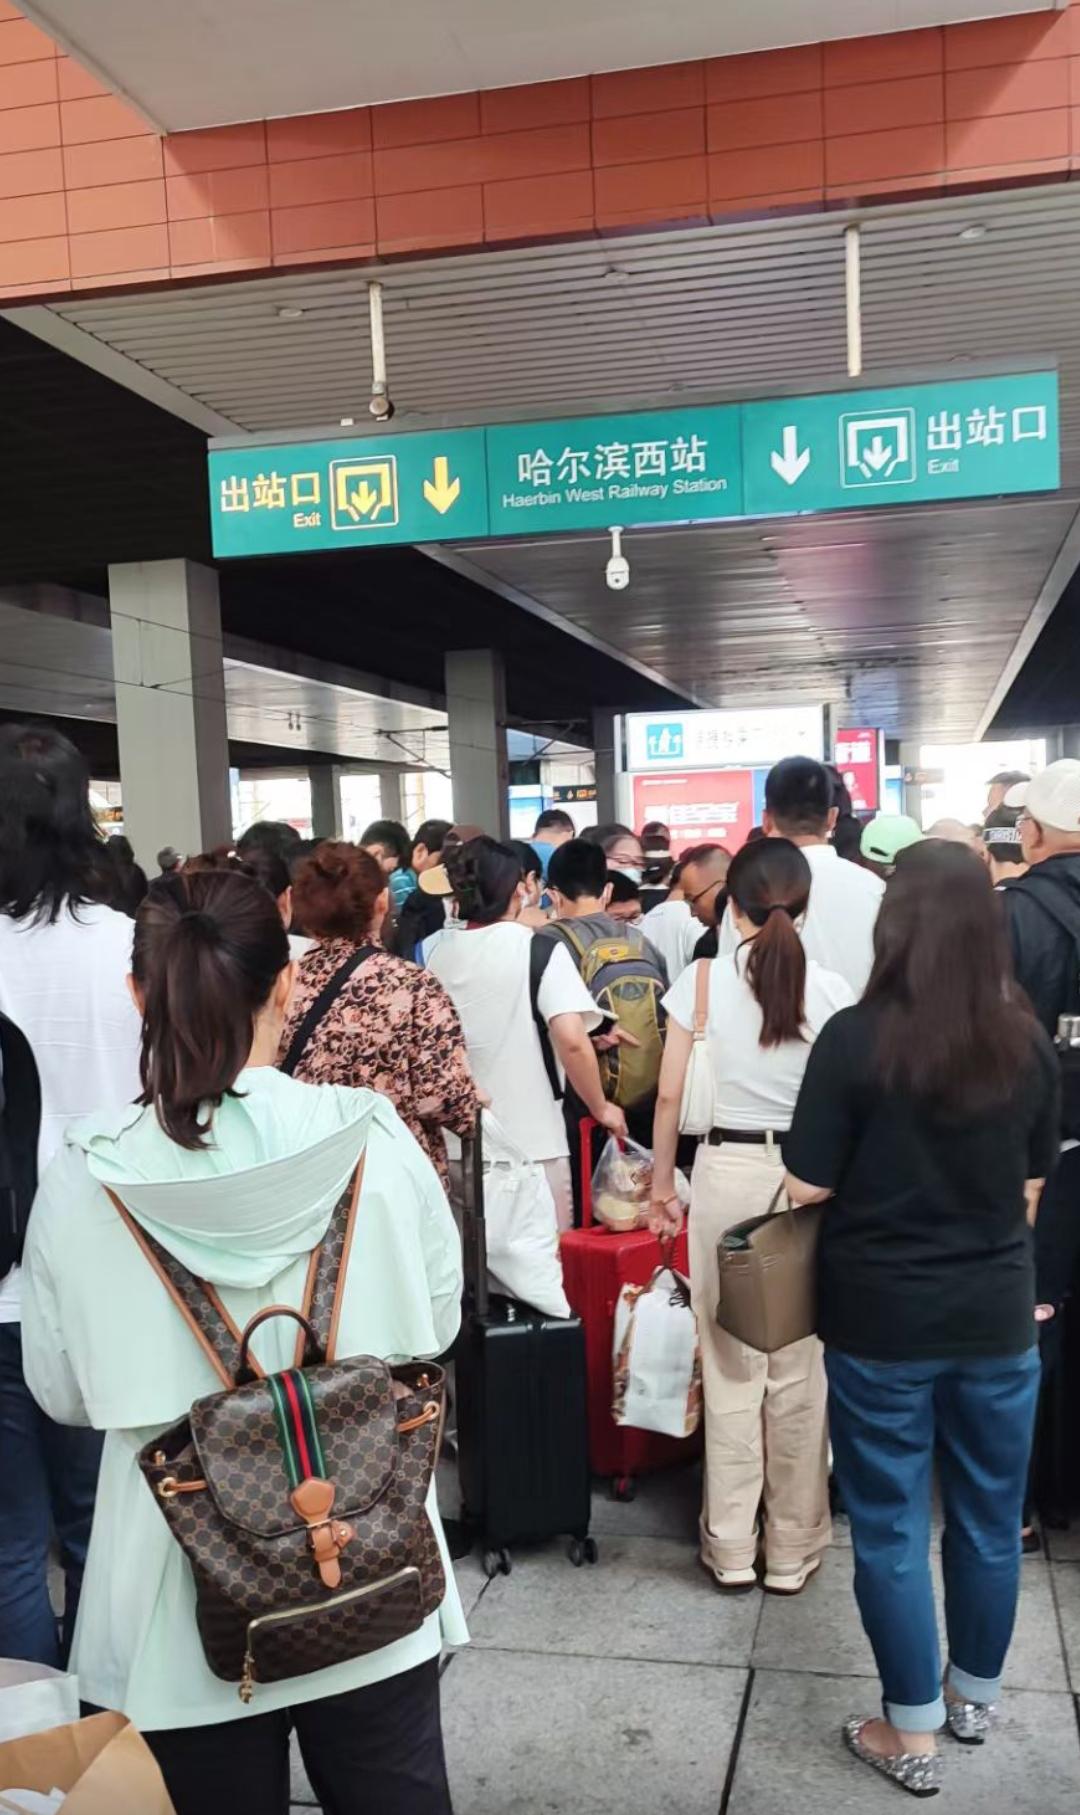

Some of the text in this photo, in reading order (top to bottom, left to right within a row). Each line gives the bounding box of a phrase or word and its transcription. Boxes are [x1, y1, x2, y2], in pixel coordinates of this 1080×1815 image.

[927, 404, 1047, 452] 出站口
[517, 434, 708, 487] 哈尔滨西站
[927, 457, 960, 475] Exit
[220, 471, 321, 513] 出站口
[502, 477, 728, 509] Haerbin West Railway Station
[293, 511, 321, 528] Exit
